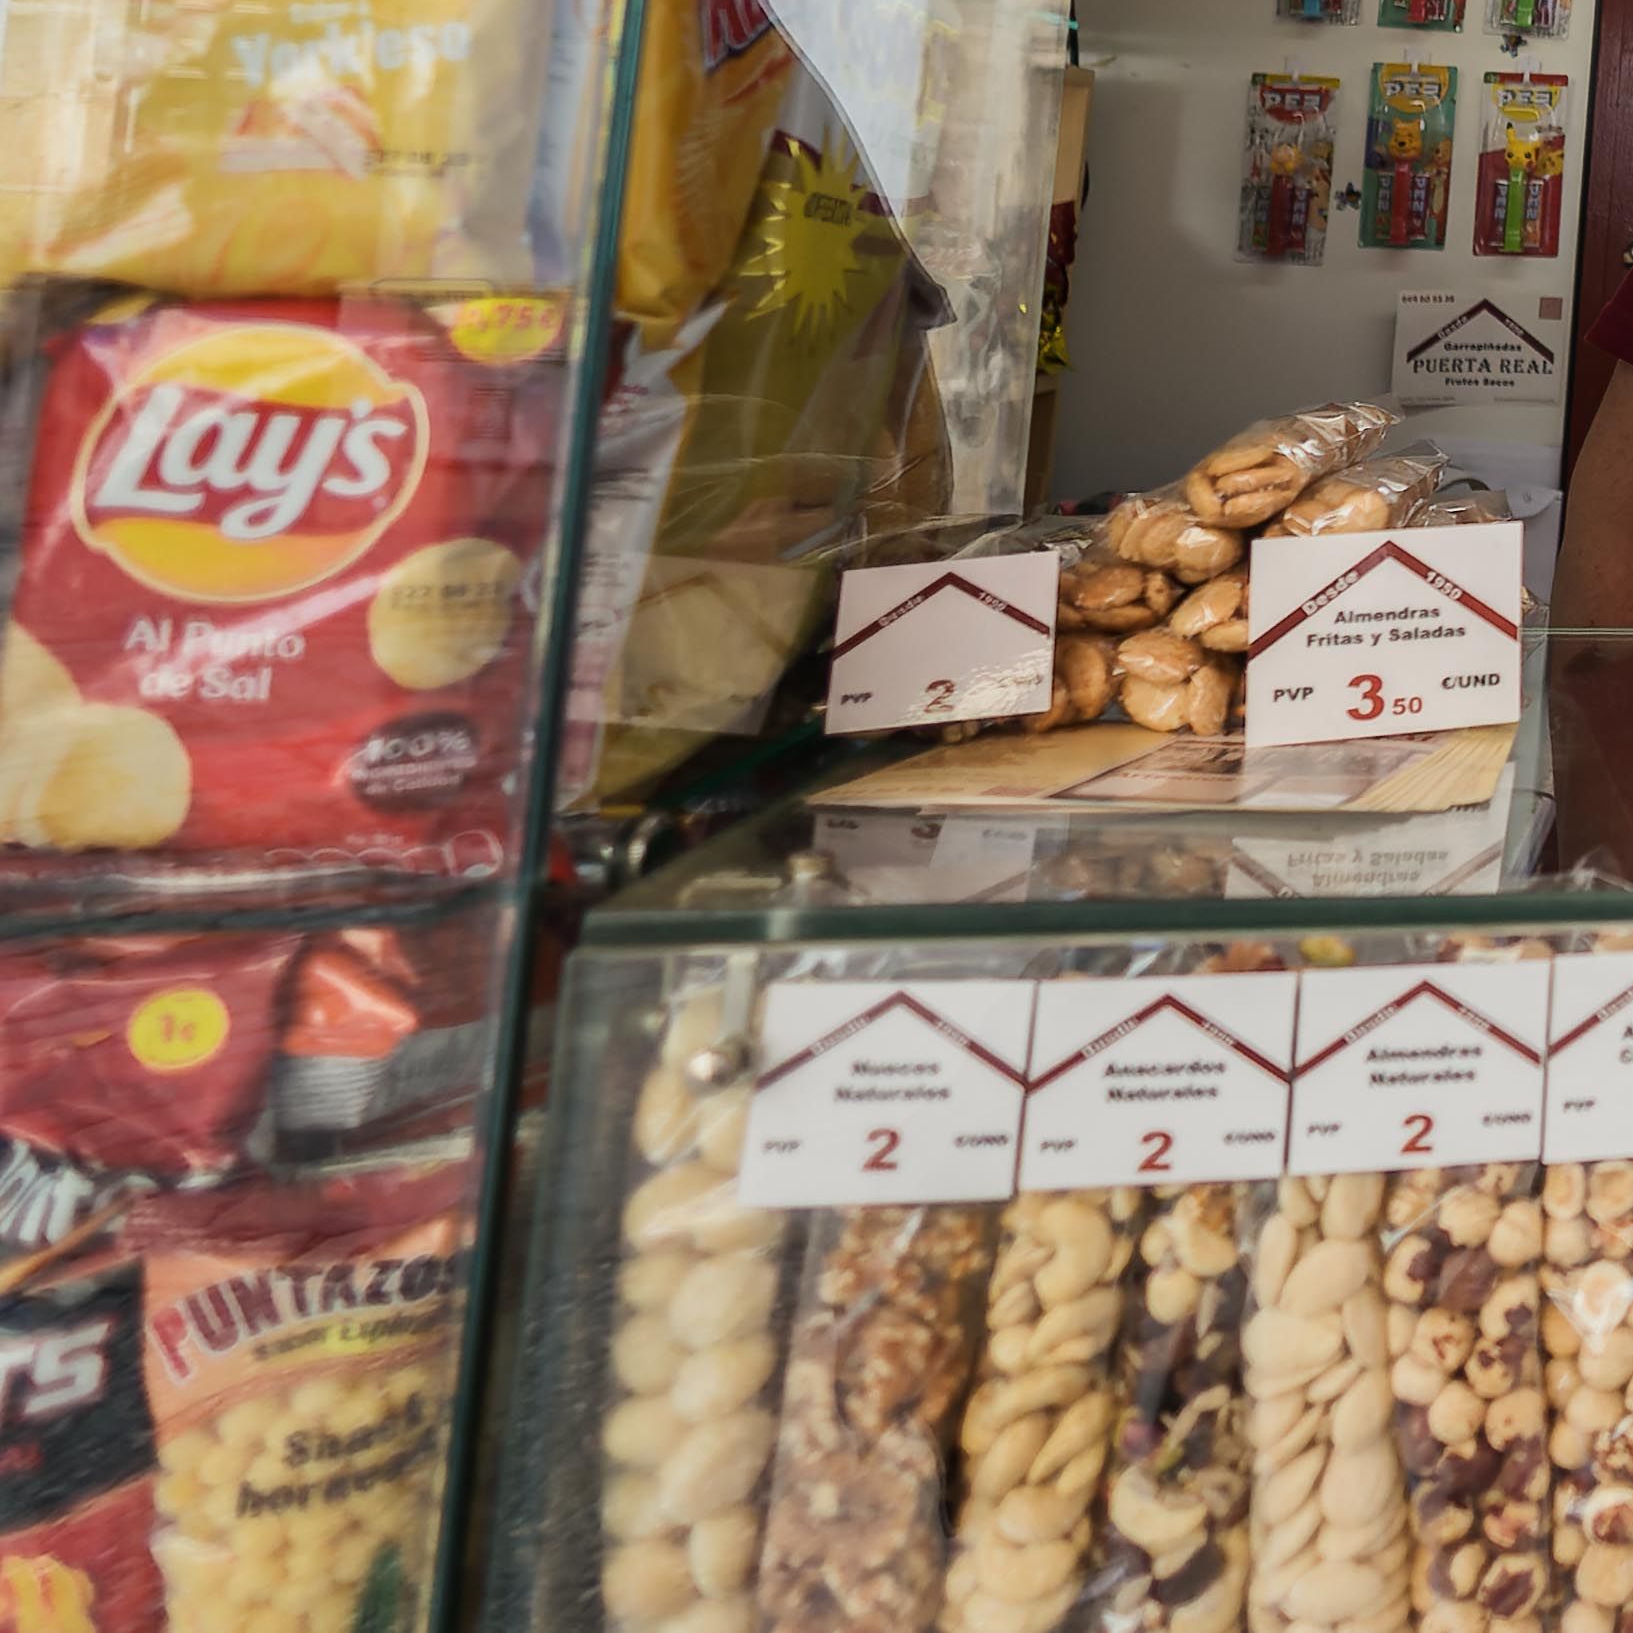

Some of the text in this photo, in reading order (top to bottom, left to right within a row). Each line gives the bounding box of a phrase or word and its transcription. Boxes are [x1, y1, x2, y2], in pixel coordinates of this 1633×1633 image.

[1413, 358, 1553, 375] PUERTA REAL
[92, 385, 408, 540] Lay's
[1333, 604, 1441, 625] Almendras
[1306, 623, 1467, 648] Fritas Saladas
[200, 667, 272, 702] Sal
[1272, 673, 1423, 722] PVP 3 50
